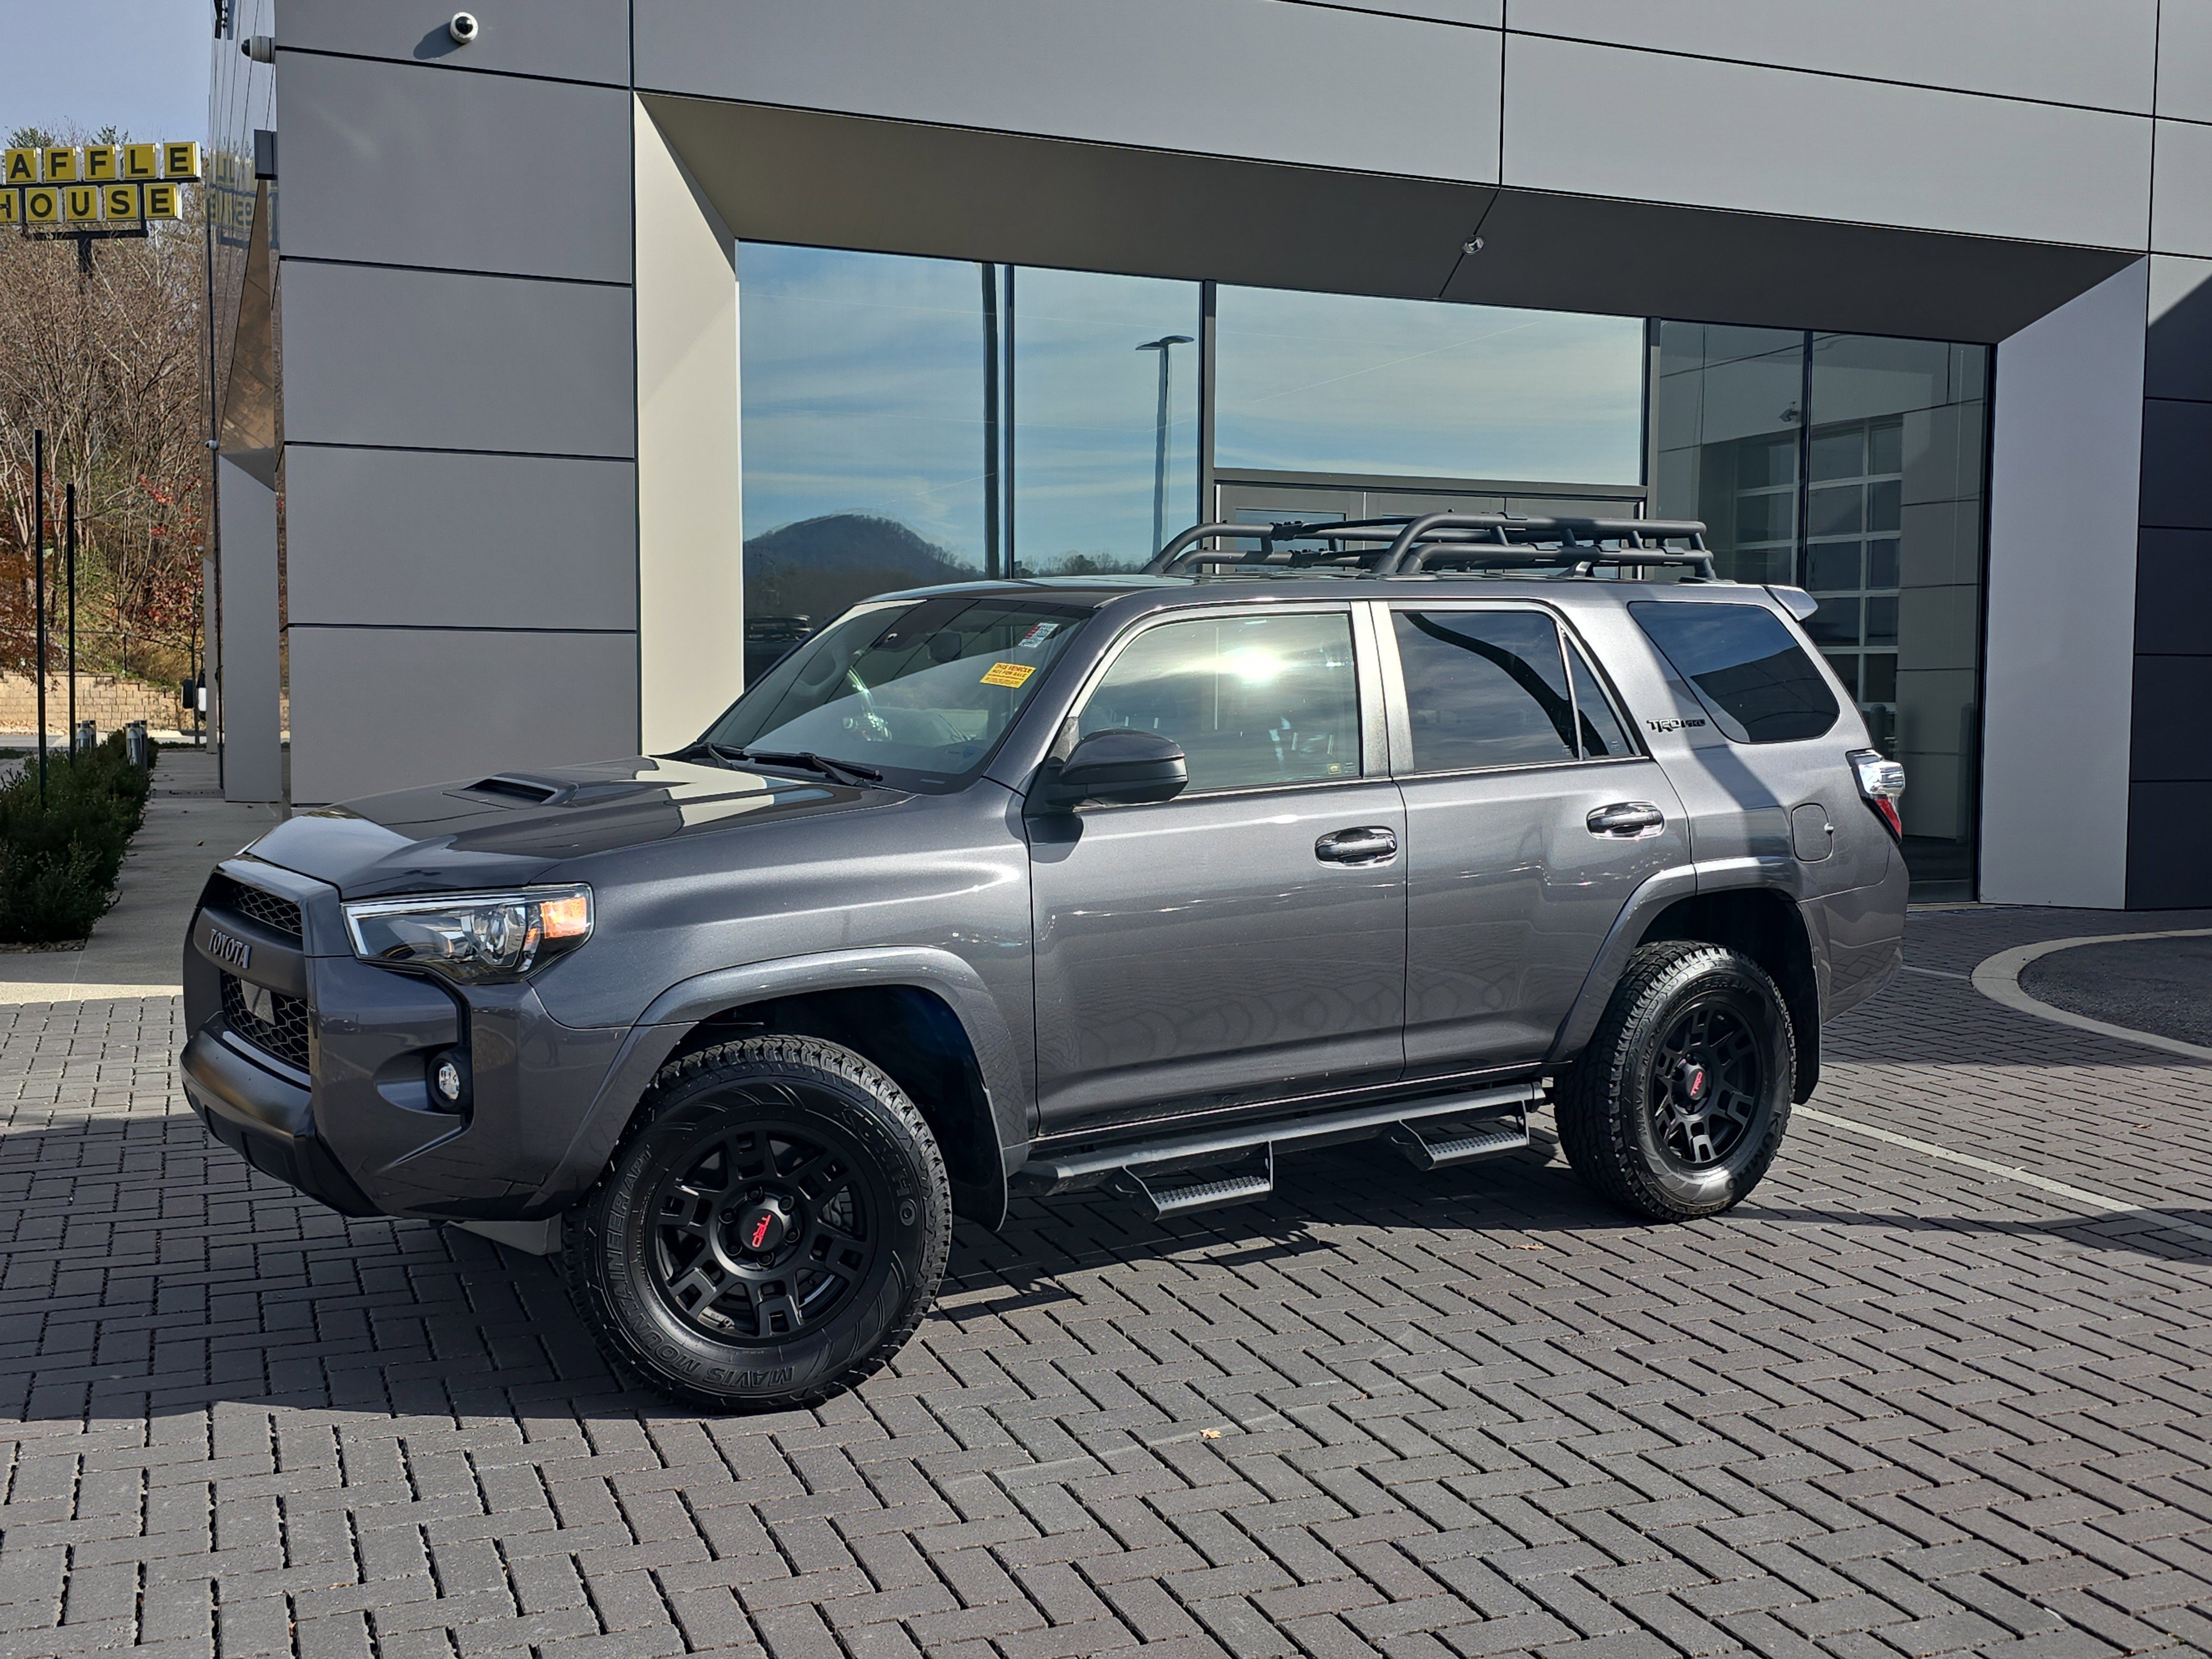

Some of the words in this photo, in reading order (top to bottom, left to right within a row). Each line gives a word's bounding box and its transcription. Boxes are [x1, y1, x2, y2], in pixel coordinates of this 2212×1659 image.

[1008, 665, 1032, 673] VEHICLE
[1647, 718, 1681, 732] TRD
[208, 928, 251, 969] TOYOTA
[623, 1144, 651, 1192] APT
[752, 1214, 771, 1248] TRD
[606, 1191, 703, 1376] MOUNTAINEER
[706, 1366, 795, 1388] MAVIS
